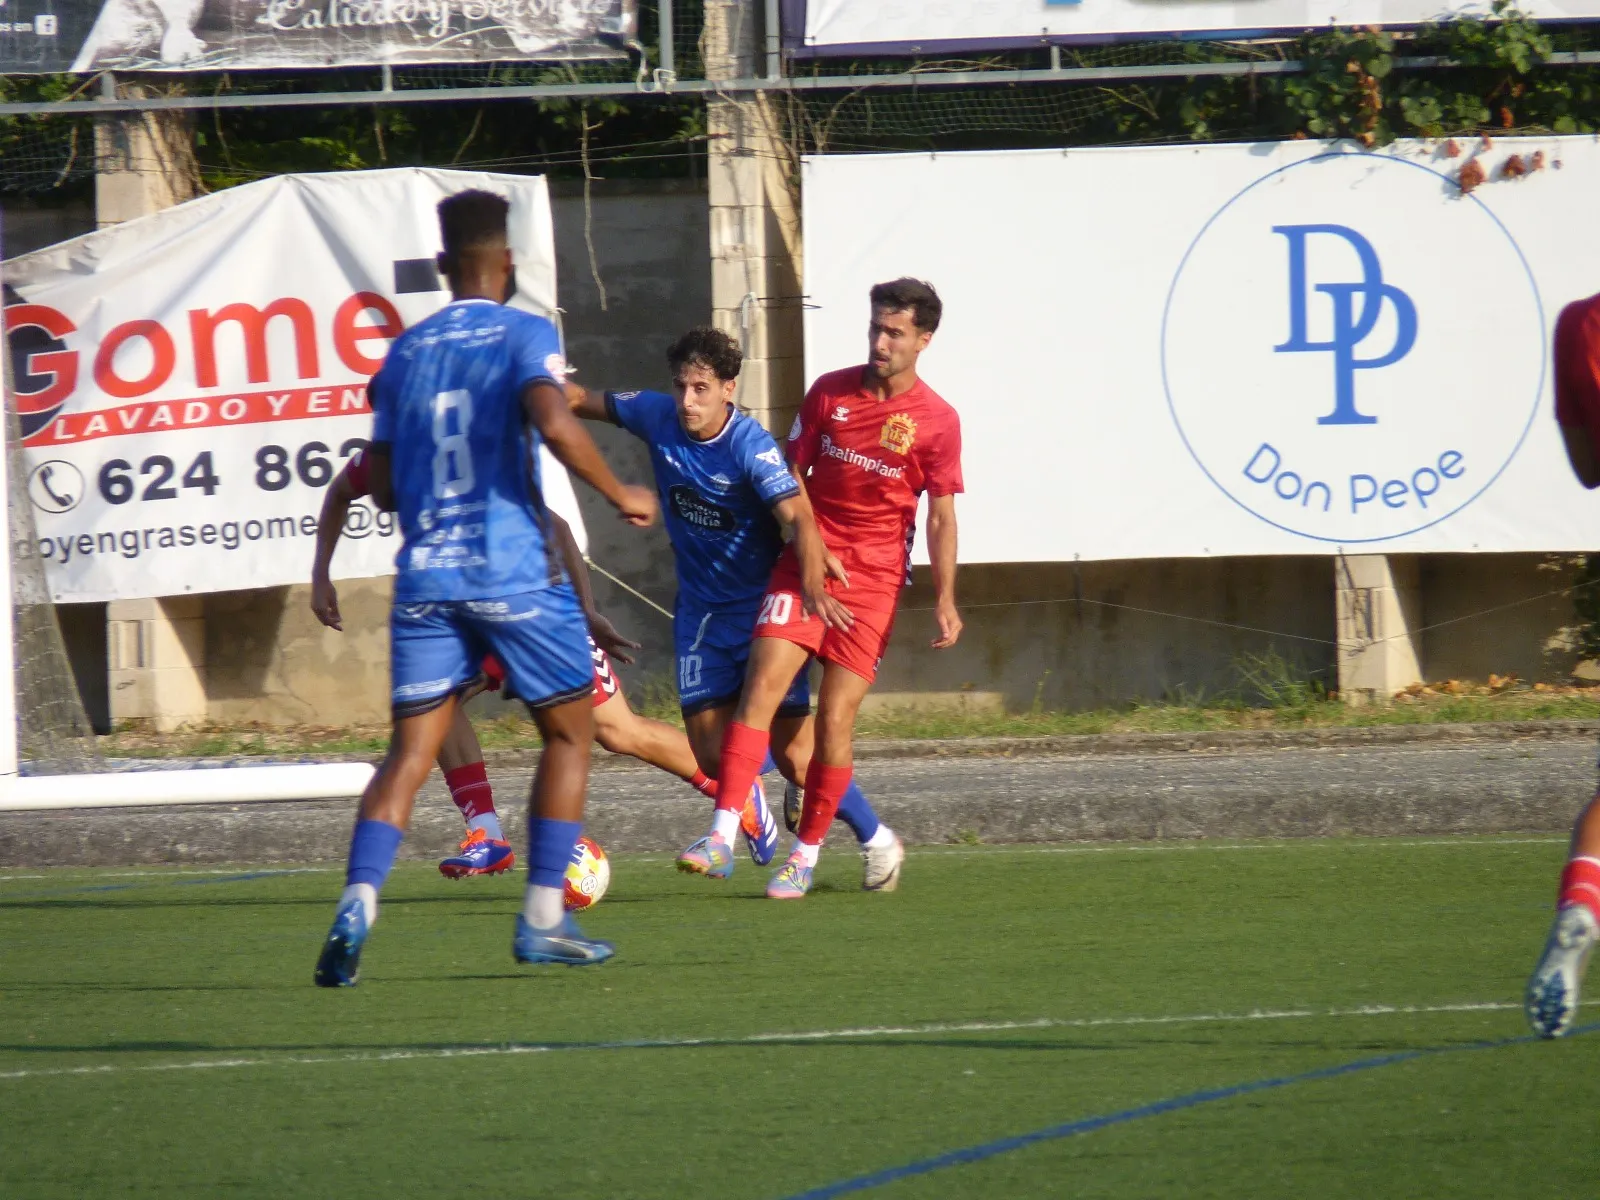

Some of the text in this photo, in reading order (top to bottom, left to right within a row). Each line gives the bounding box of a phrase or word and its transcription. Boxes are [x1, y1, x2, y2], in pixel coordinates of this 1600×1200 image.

[53, 387, 367, 441] LAVADO Y EN
[430, 388, 475, 499] 8
[97, 450, 220, 506] 624
[1243, 442, 1466, 515] Don Pepe
[757, 593, 793, 625] 20
[679, 655, 702, 690] 10
